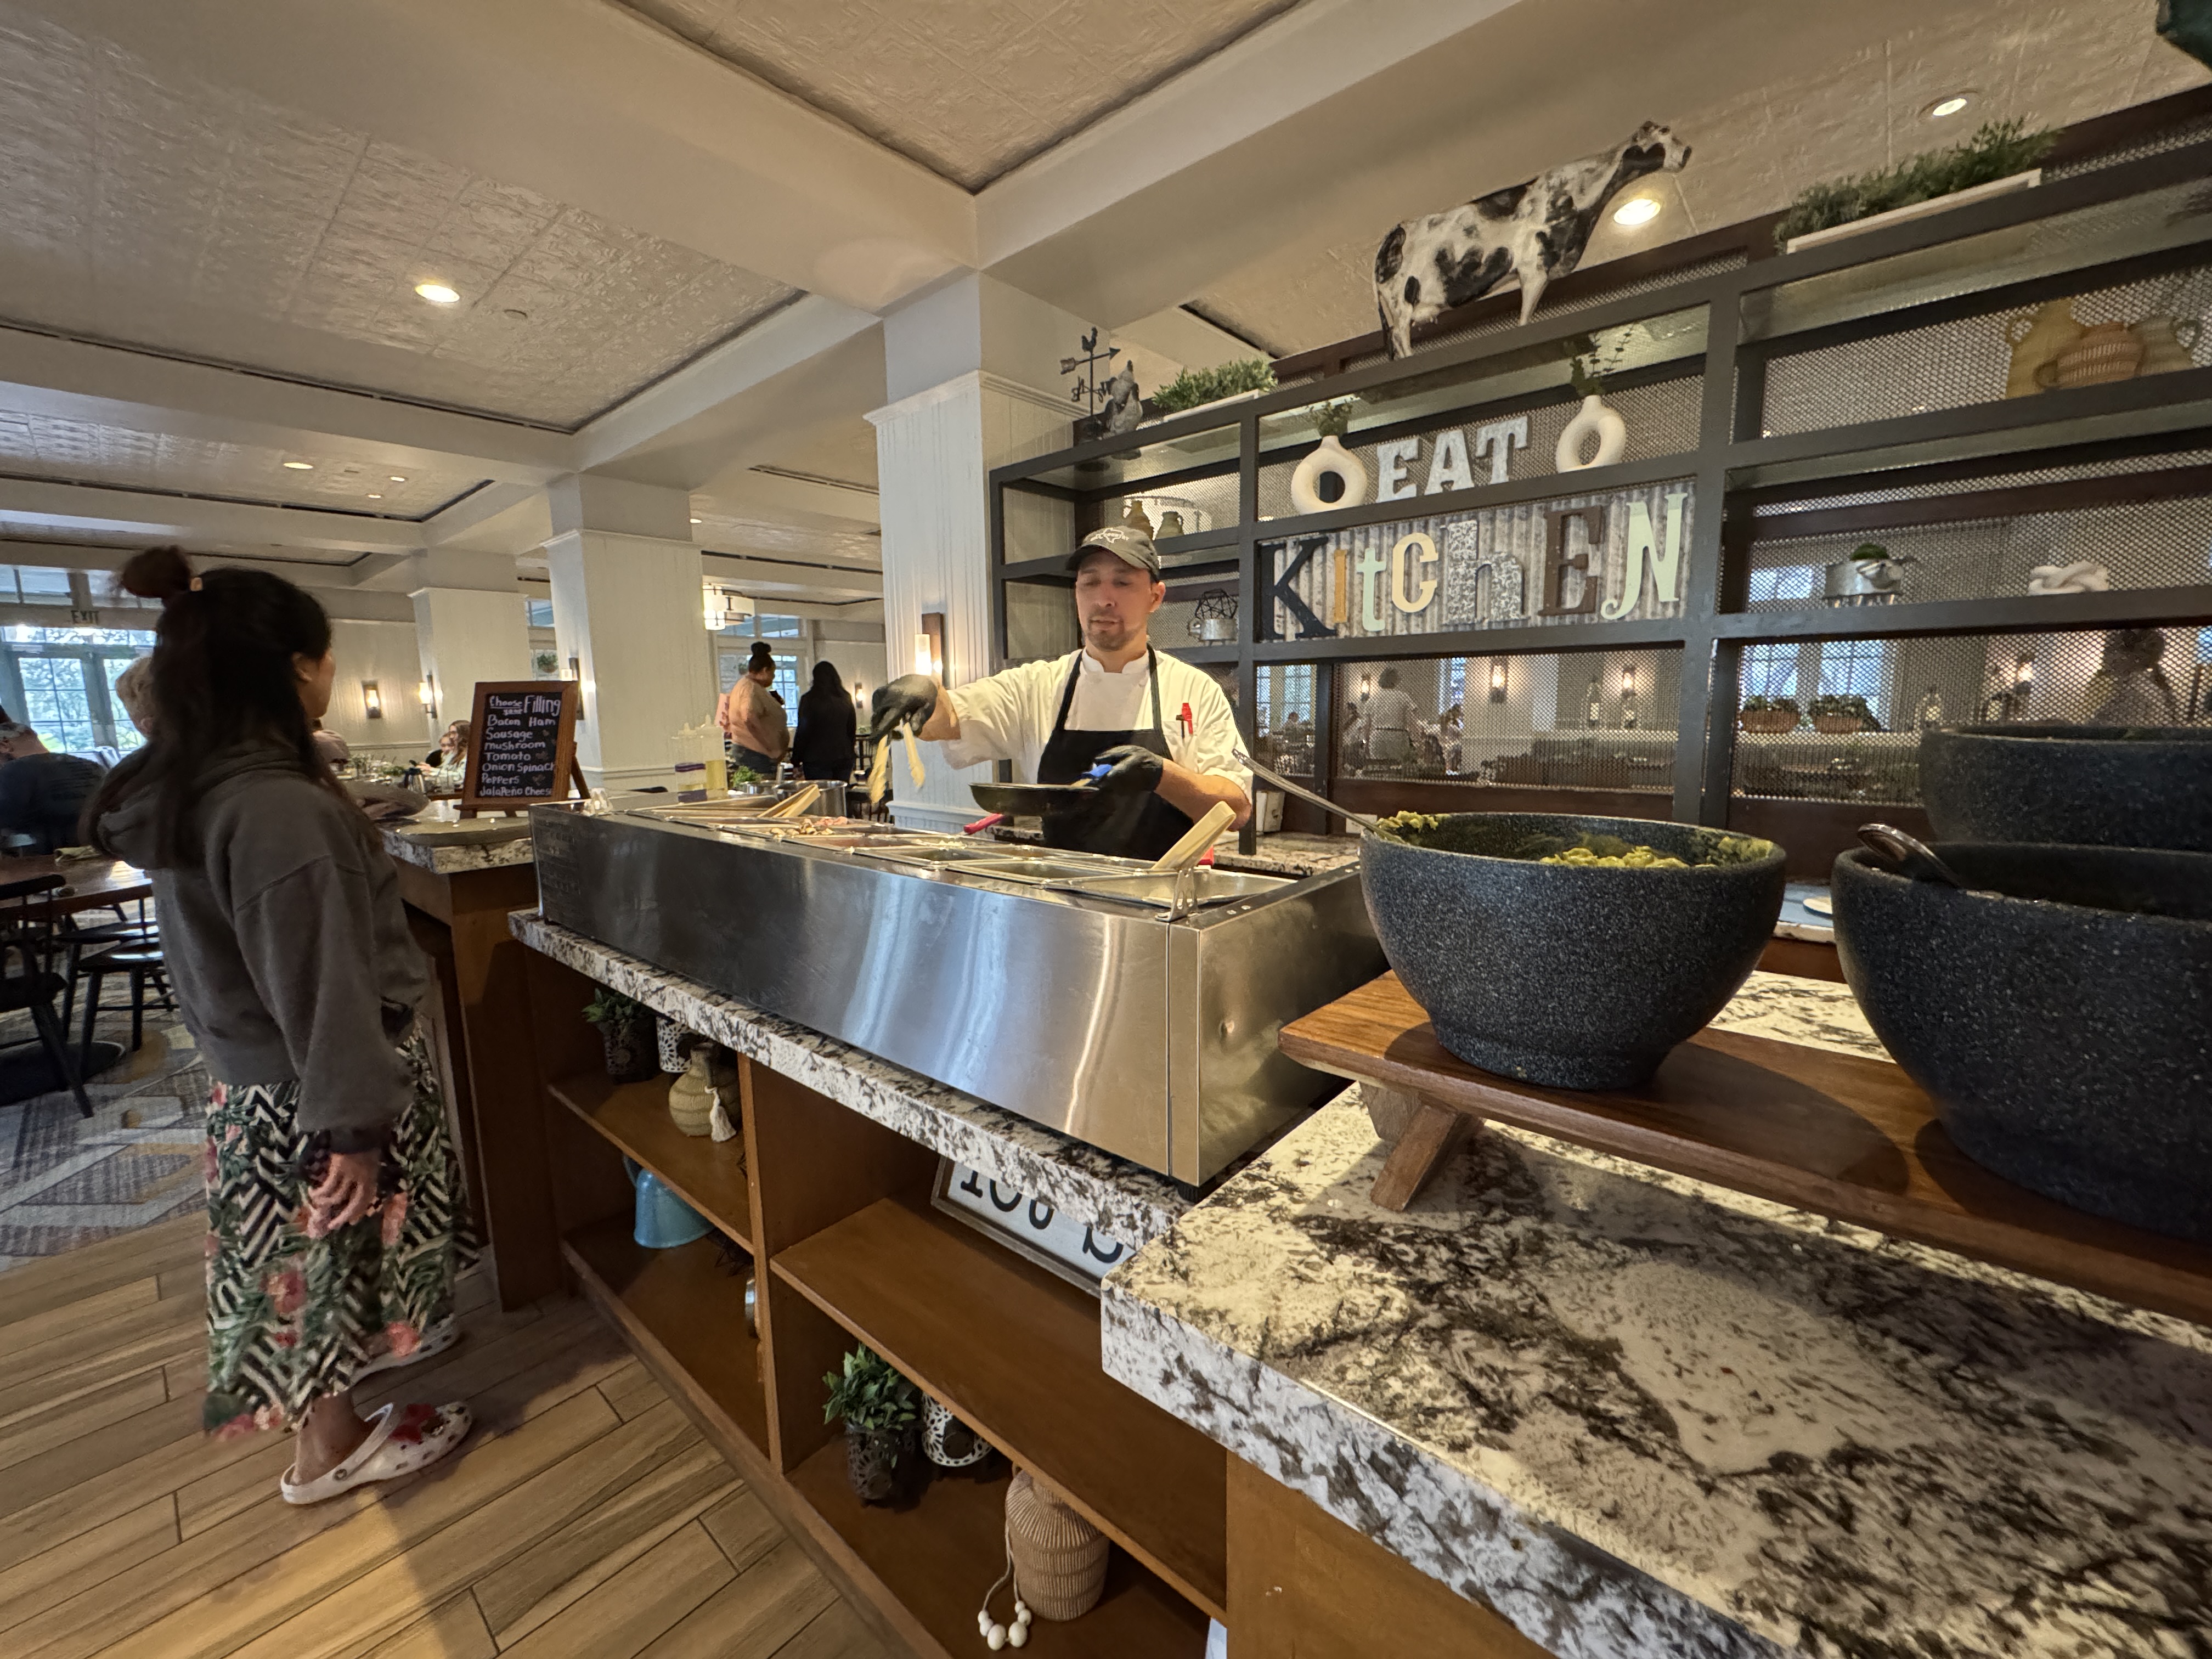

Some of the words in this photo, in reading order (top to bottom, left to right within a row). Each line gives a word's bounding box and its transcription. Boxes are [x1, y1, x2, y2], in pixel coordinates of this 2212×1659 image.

[1375, 416, 1528, 503] EAT
[71, 610, 99, 625] EXIT
[489, 696, 523, 707] Choose
[524, 695, 561, 717] Filling
[487, 714, 521, 726] Bacon
[528, 716, 556, 727] Ham
[485, 727, 533, 742] Sausage
[484, 752, 531, 761] Tomato
[482, 763, 515, 772] Onion
